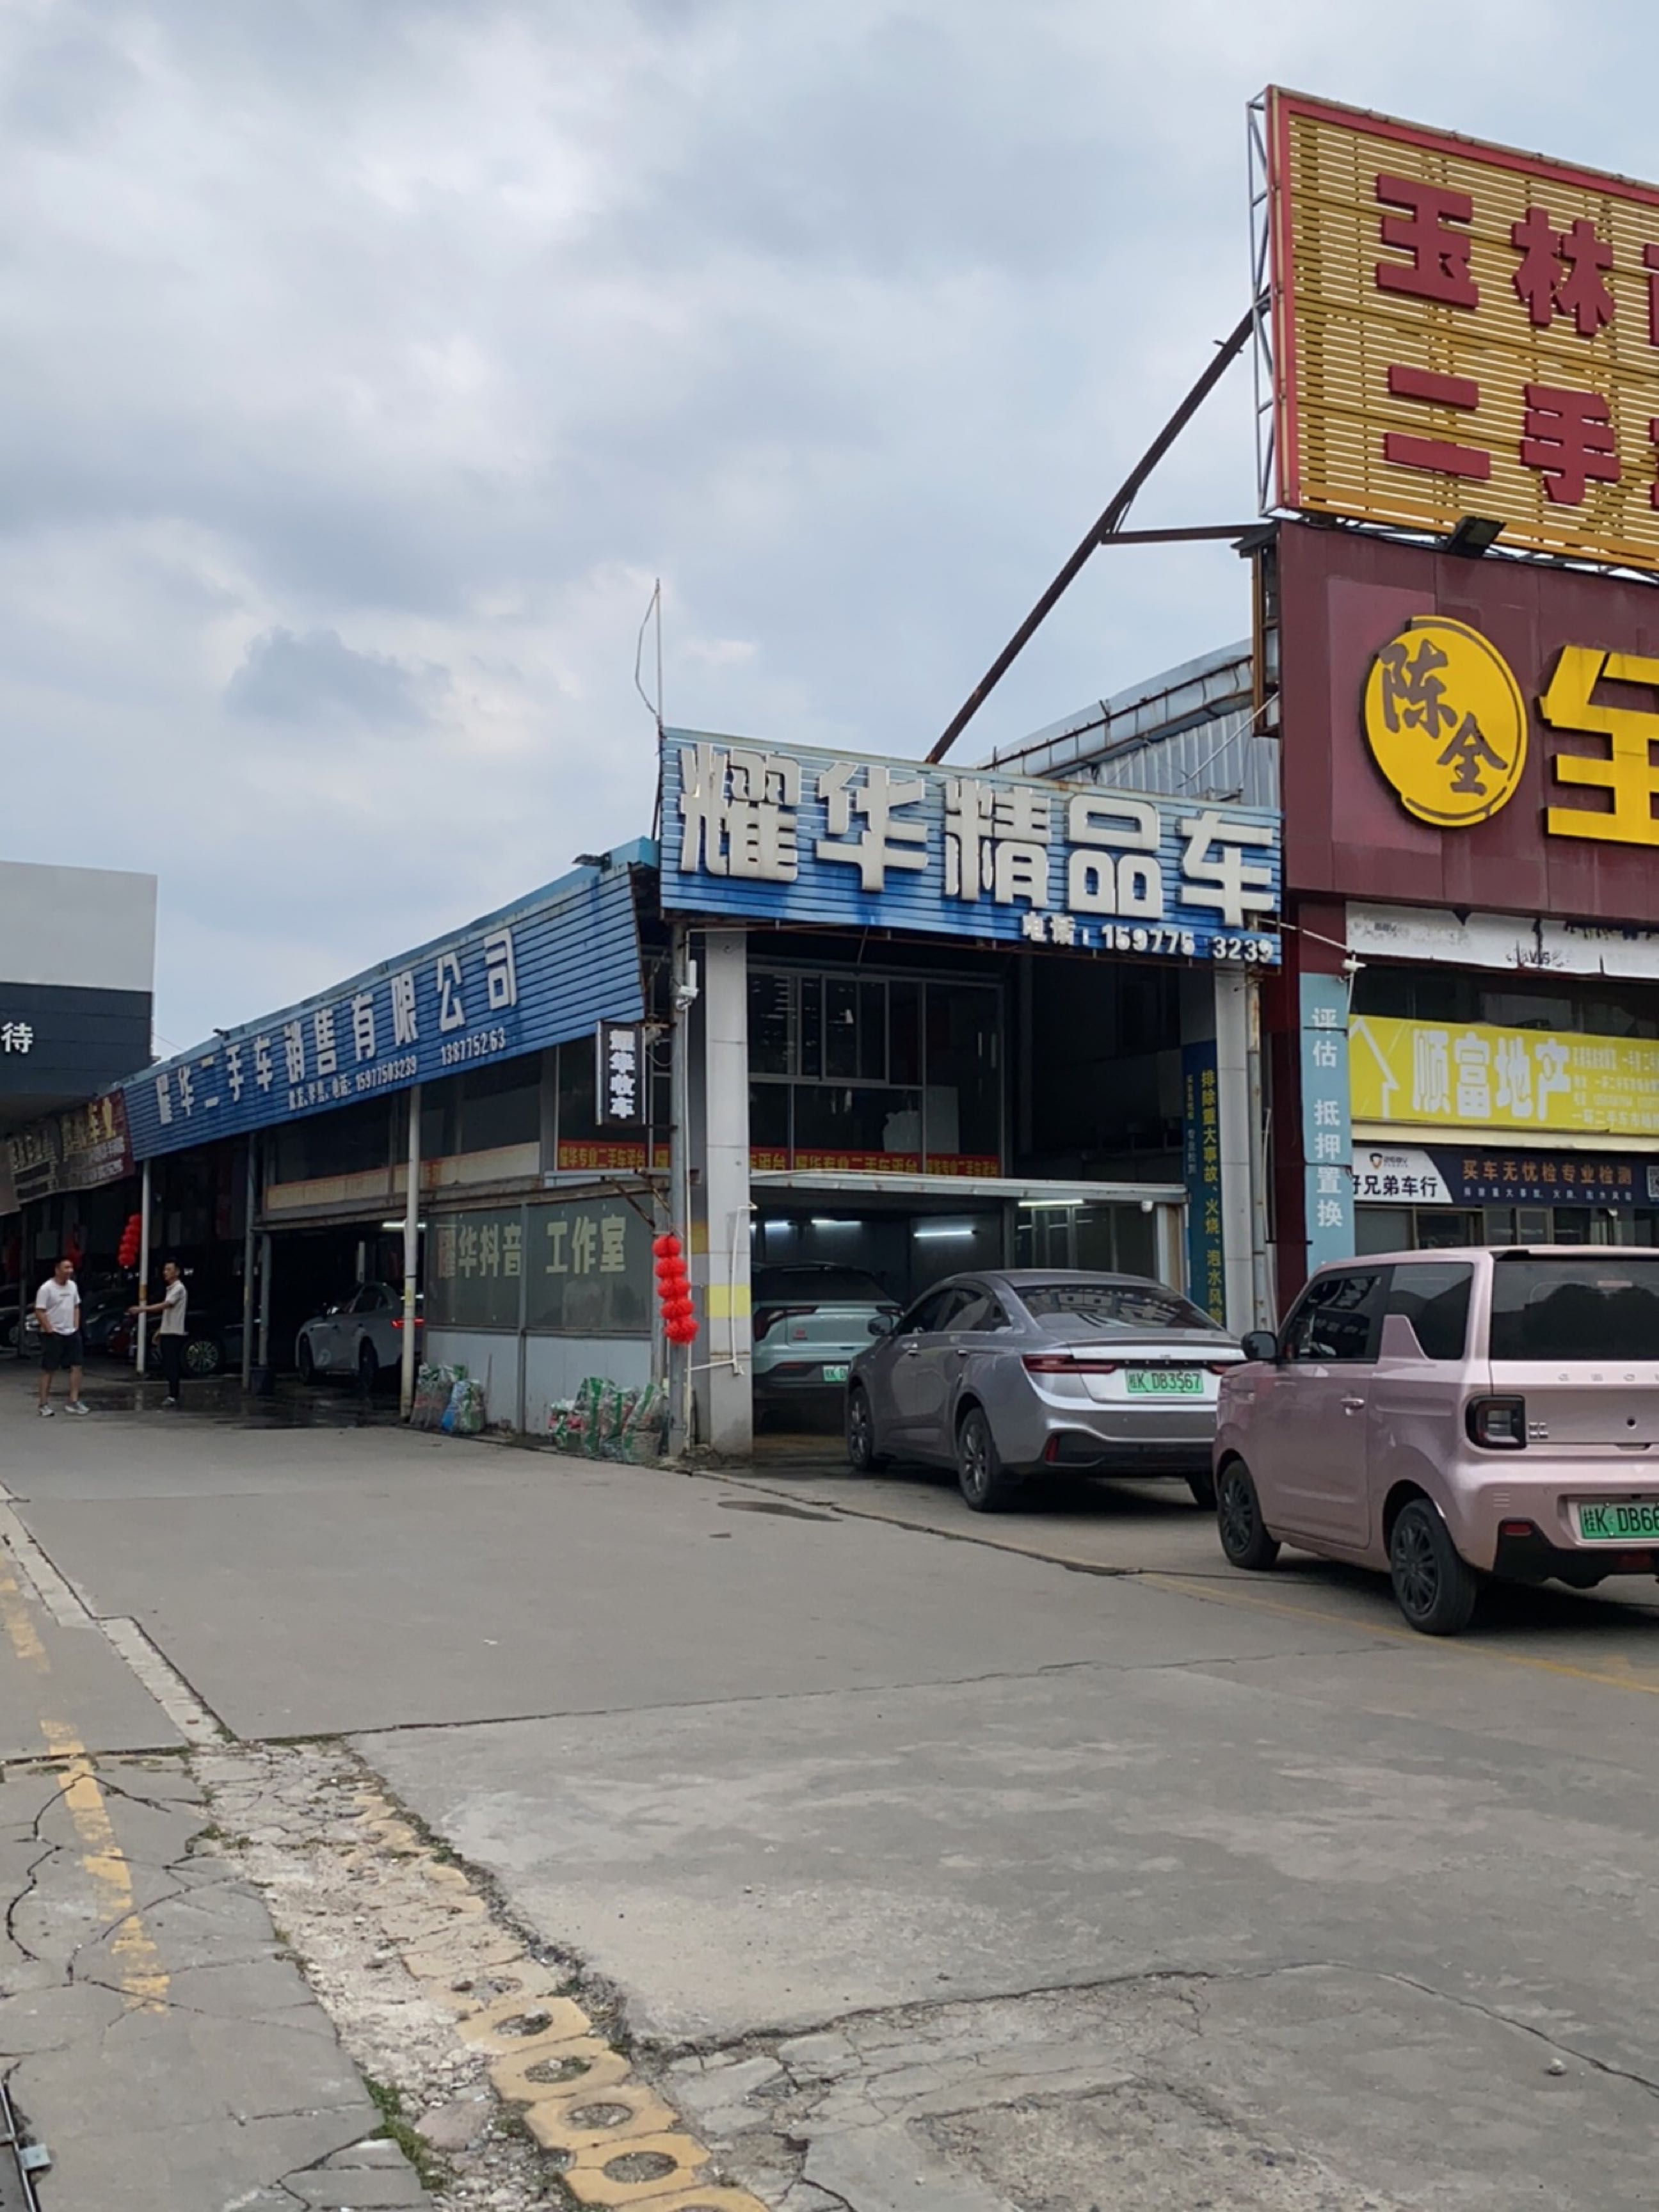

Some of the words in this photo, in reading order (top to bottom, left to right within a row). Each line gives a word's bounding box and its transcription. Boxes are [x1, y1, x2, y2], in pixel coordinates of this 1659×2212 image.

[1376, 172, 1659, 348] 玉林
[1383, 364, 1659, 510] 二手
[680, 742, 1276, 927] 耀华精品车
[1212, 935, 1274, 964] 3239
[1, 1022, 33, 1054] 待
[156, 928, 518, 1126] 耀华二手车销售有限公司
[1311, 1007, 1338, 1068] 评估
[1413, 1027, 1571, 1122] 顺富地产
[1313, 1100, 1343, 1228] 抵押置换
[546, 1214, 627, 1274] 工作室
